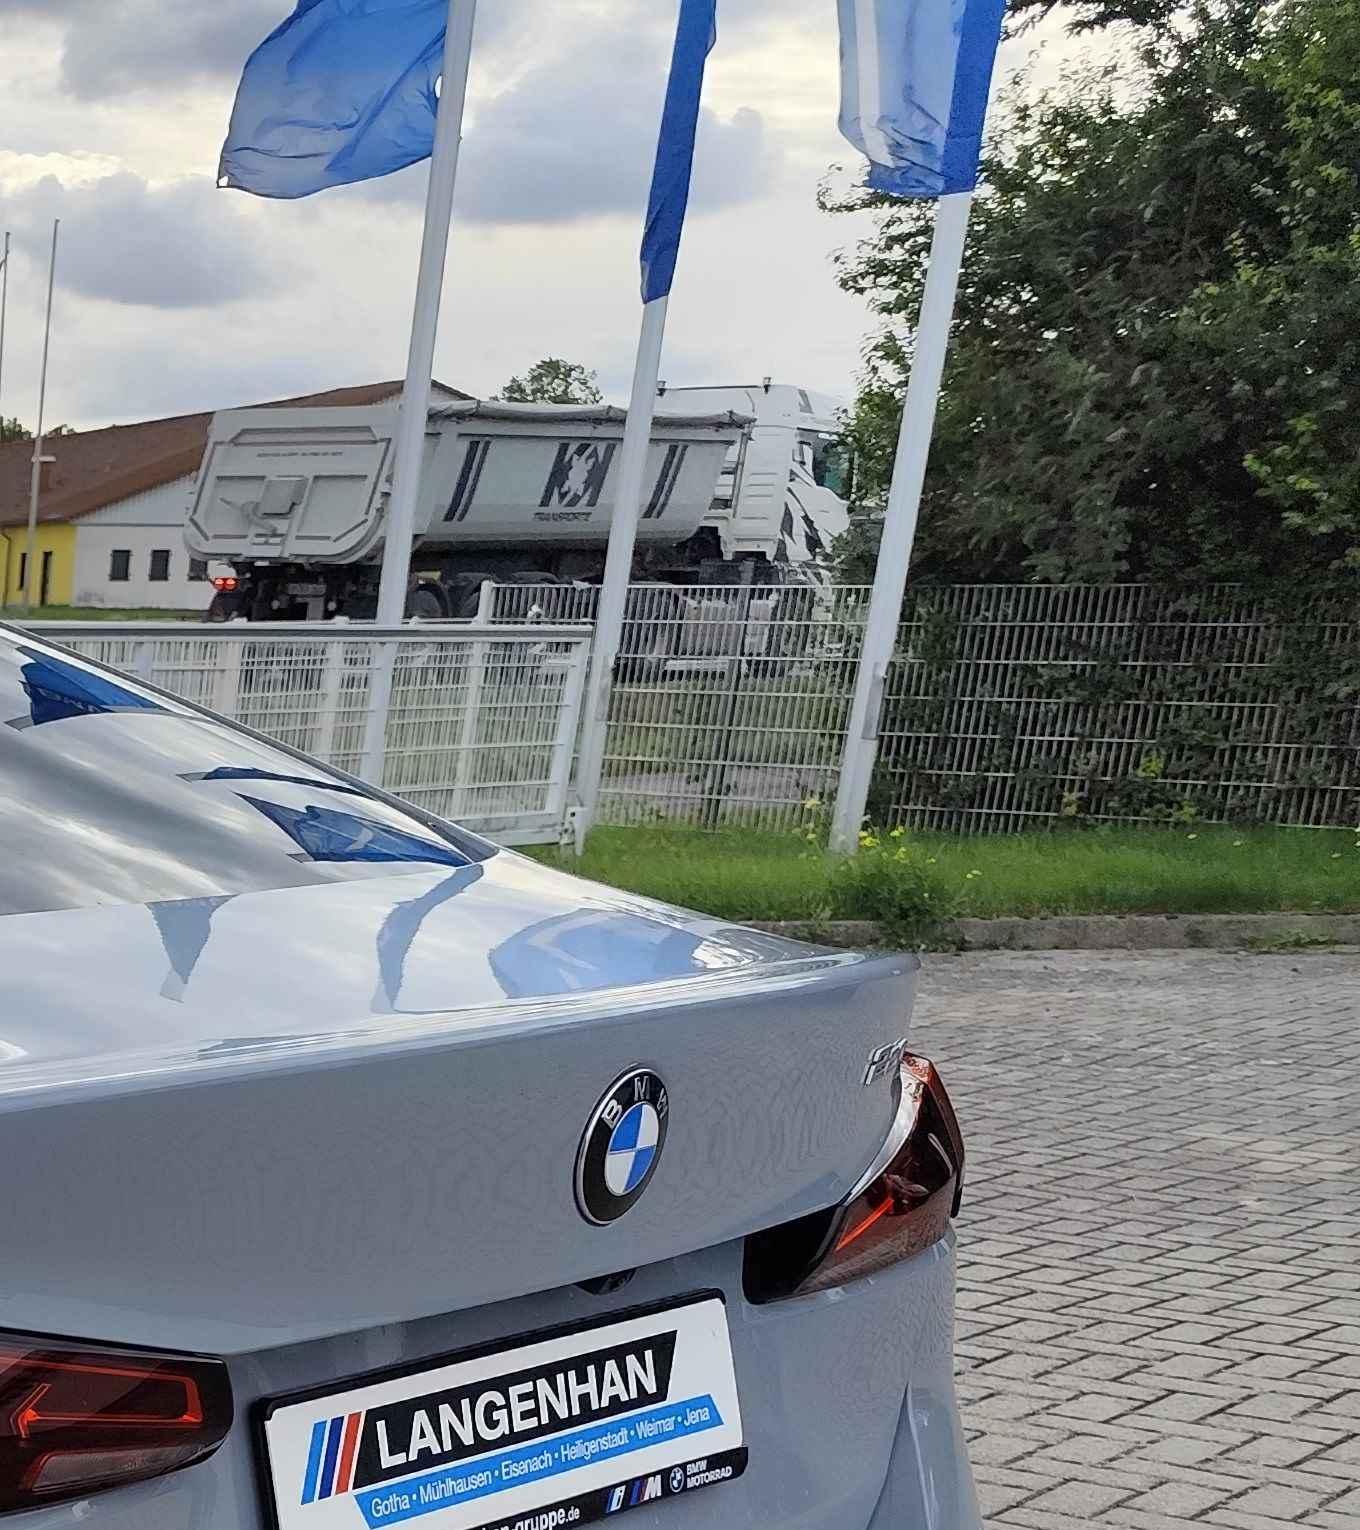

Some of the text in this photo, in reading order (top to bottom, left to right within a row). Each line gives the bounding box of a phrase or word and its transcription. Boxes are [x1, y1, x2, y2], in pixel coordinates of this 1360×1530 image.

[601, 1075, 669, 1130] BMW
[376, 1349, 657, 1469] LANGENHAN
[372, 1406, 710, 1518] Gotha Mühlhausen Eisenach Heiligenstadt Weimar Jena
[686, 1459, 708, 1475] BMW
[686, 1465, 733, 1489] MOTORRAD
